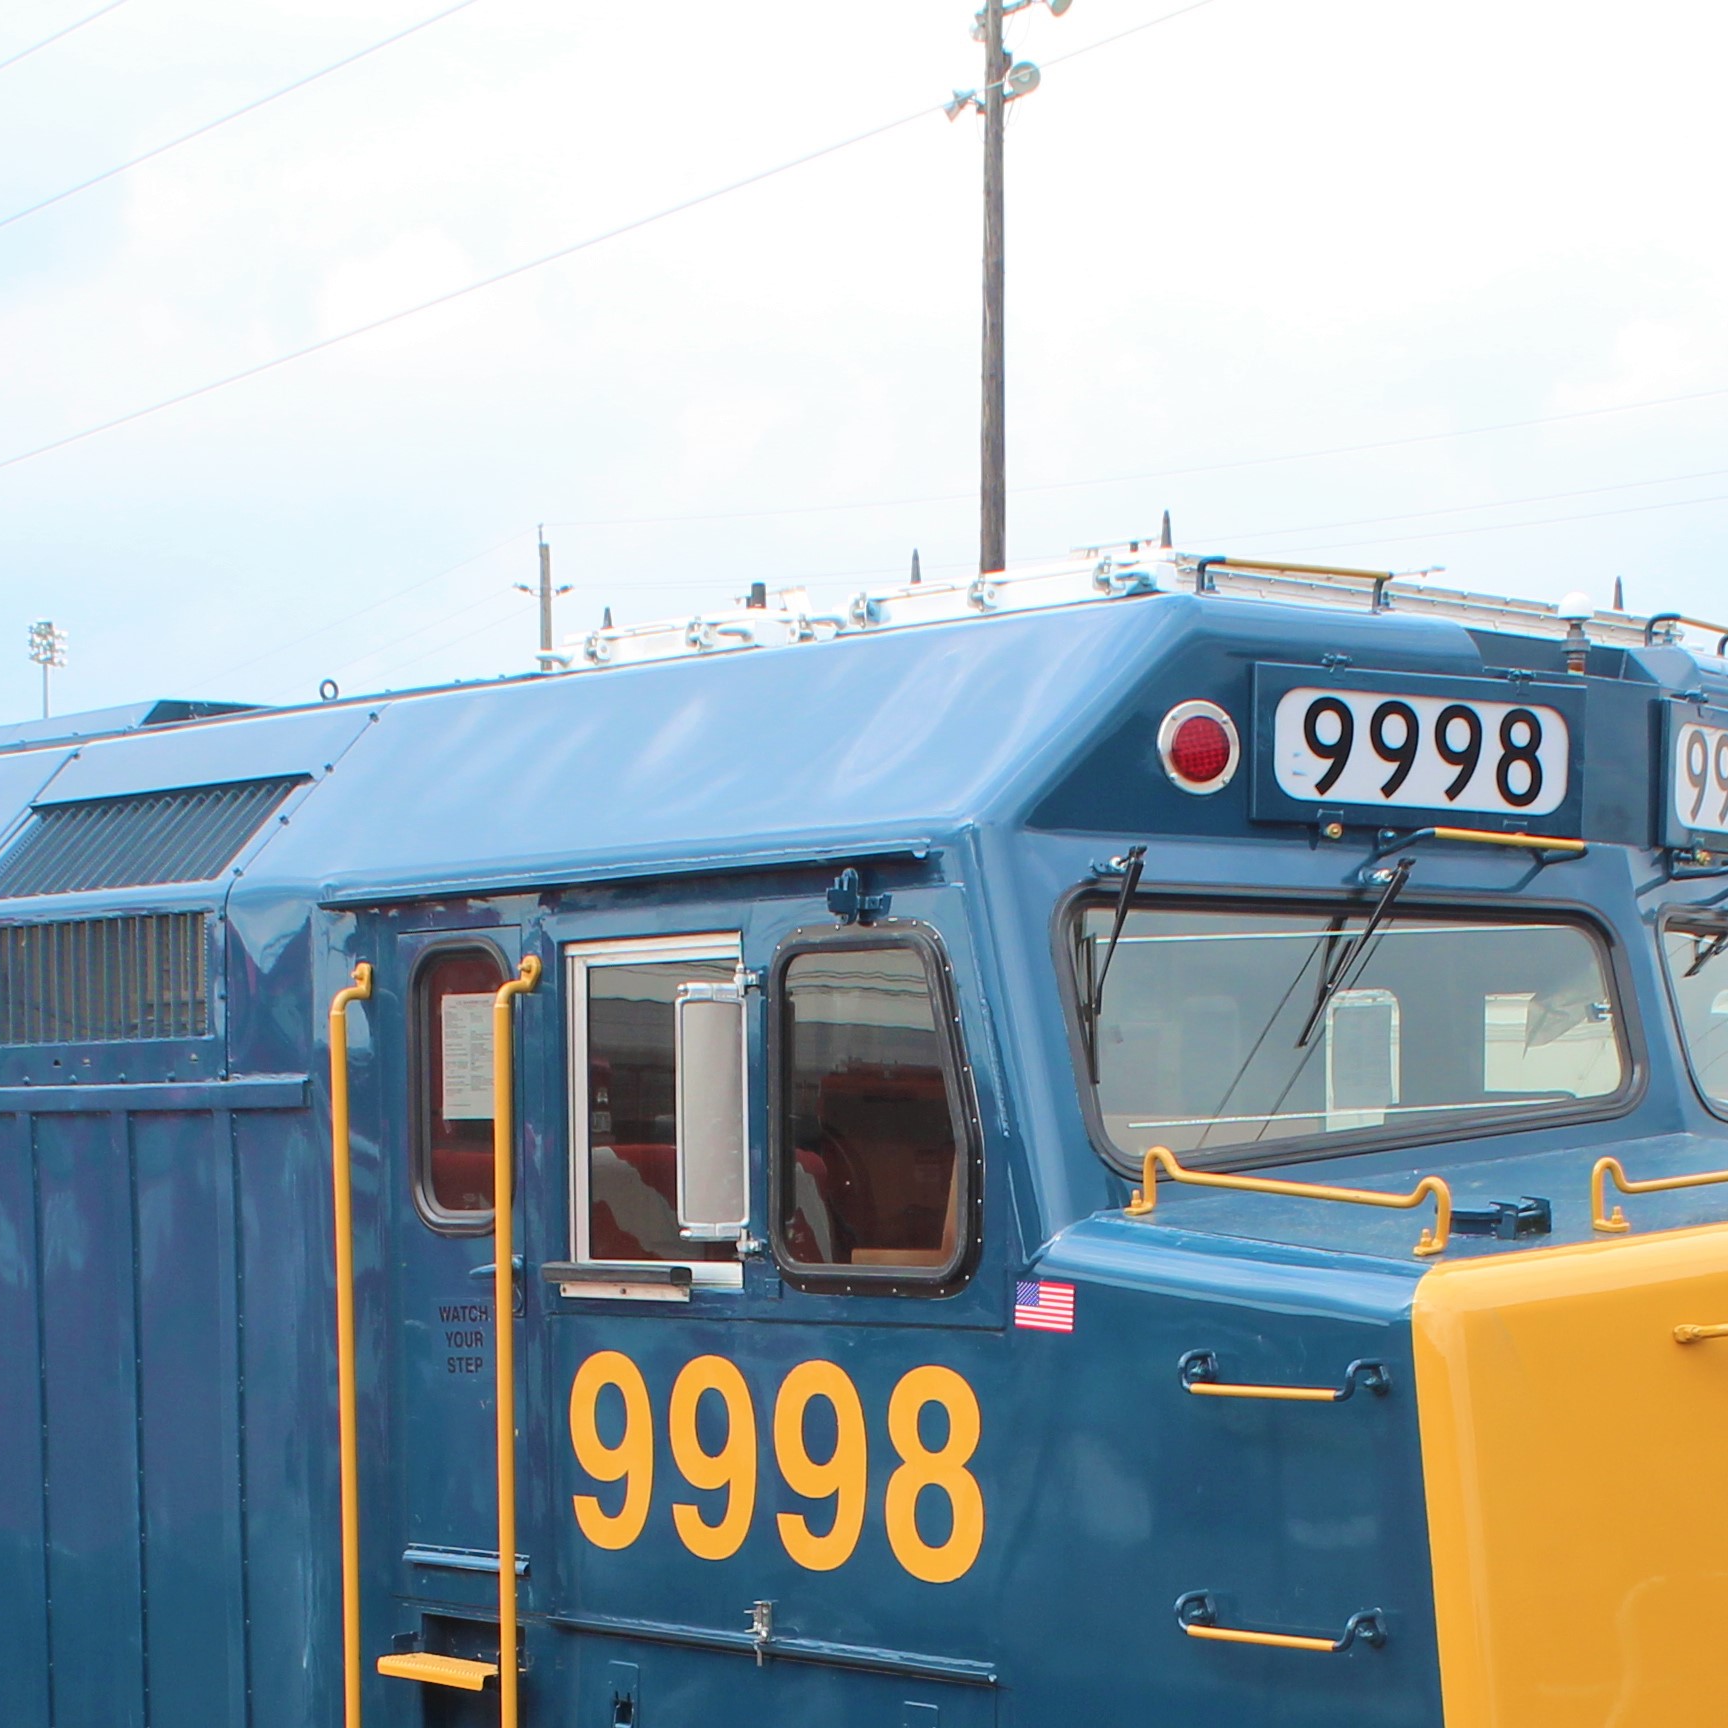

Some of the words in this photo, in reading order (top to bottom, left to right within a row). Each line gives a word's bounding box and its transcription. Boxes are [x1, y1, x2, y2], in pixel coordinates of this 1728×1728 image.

[1304, 696, 1543, 807] 9998
[439, 1305, 489, 1322] WATCH
[446, 1331, 483, 1348] YOUR
[447, 1357, 483, 1373] STEP
[569, 1350, 985, 1584] 9998
